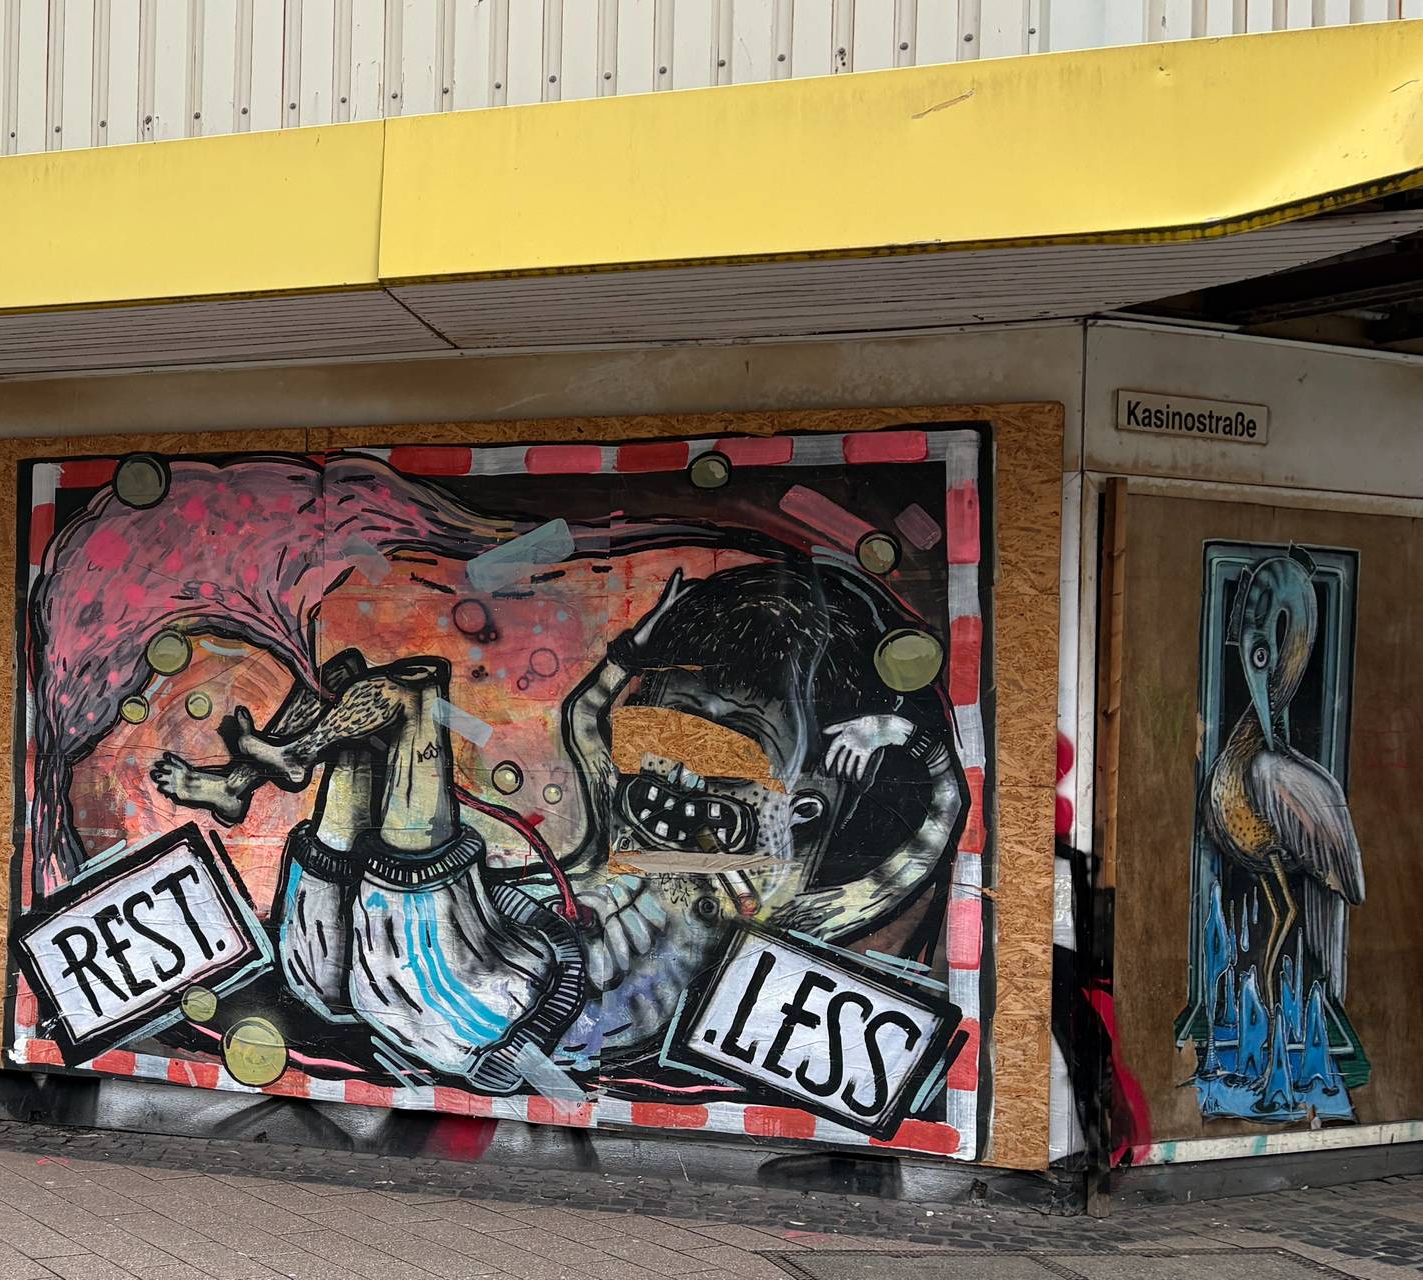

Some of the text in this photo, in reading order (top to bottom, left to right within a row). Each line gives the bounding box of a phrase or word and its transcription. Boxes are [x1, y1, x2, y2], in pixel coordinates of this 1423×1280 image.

[1126, 400, 1257, 438] Kasinostraße
[52, 864, 226, 1017] REST.
[703, 951, 921, 1117] .LESS
